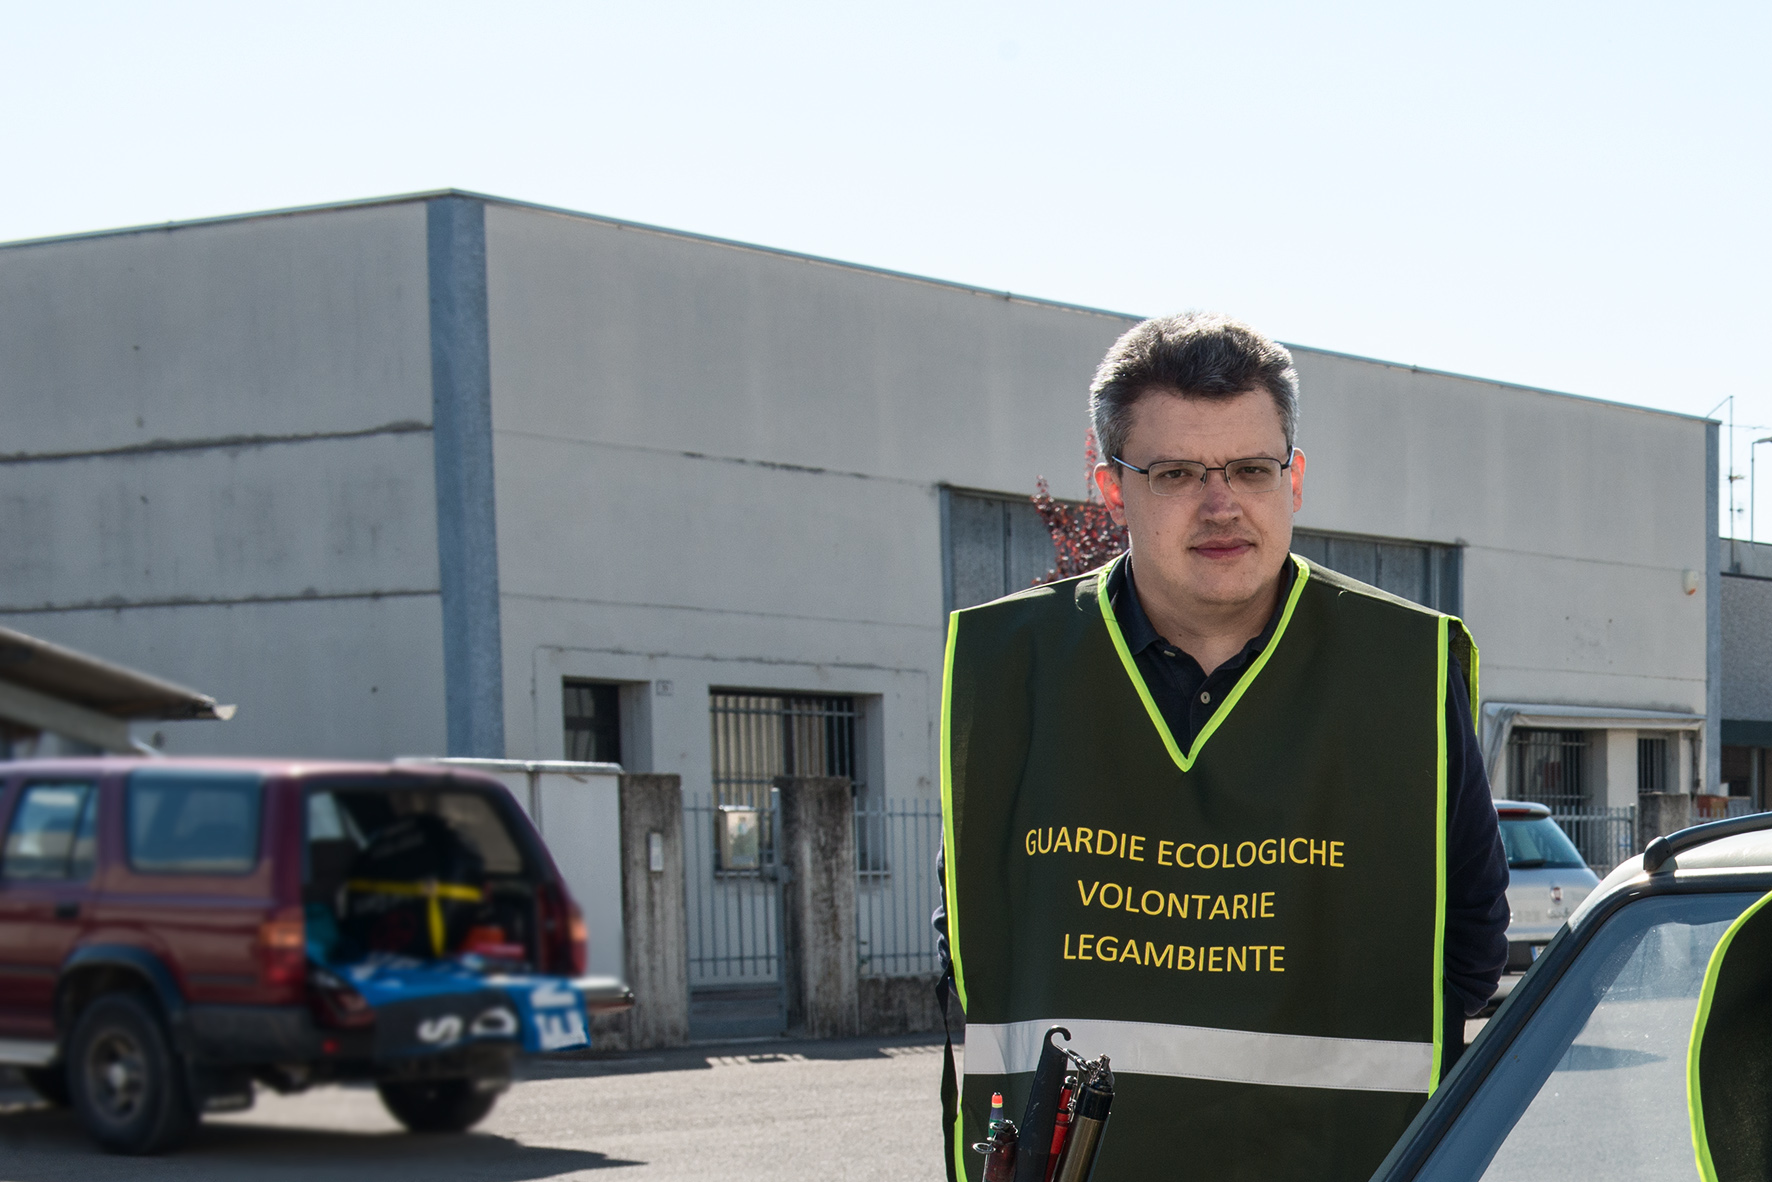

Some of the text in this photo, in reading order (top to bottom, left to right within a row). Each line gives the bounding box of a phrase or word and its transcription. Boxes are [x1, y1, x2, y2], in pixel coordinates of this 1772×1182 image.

[1025, 826, 1345, 869] GUARDIE ECOLOGICHE
[1077, 879, 1276, 920] VOLONTARIE
[1063, 933, 1286, 972] LEGAMBIENTE
